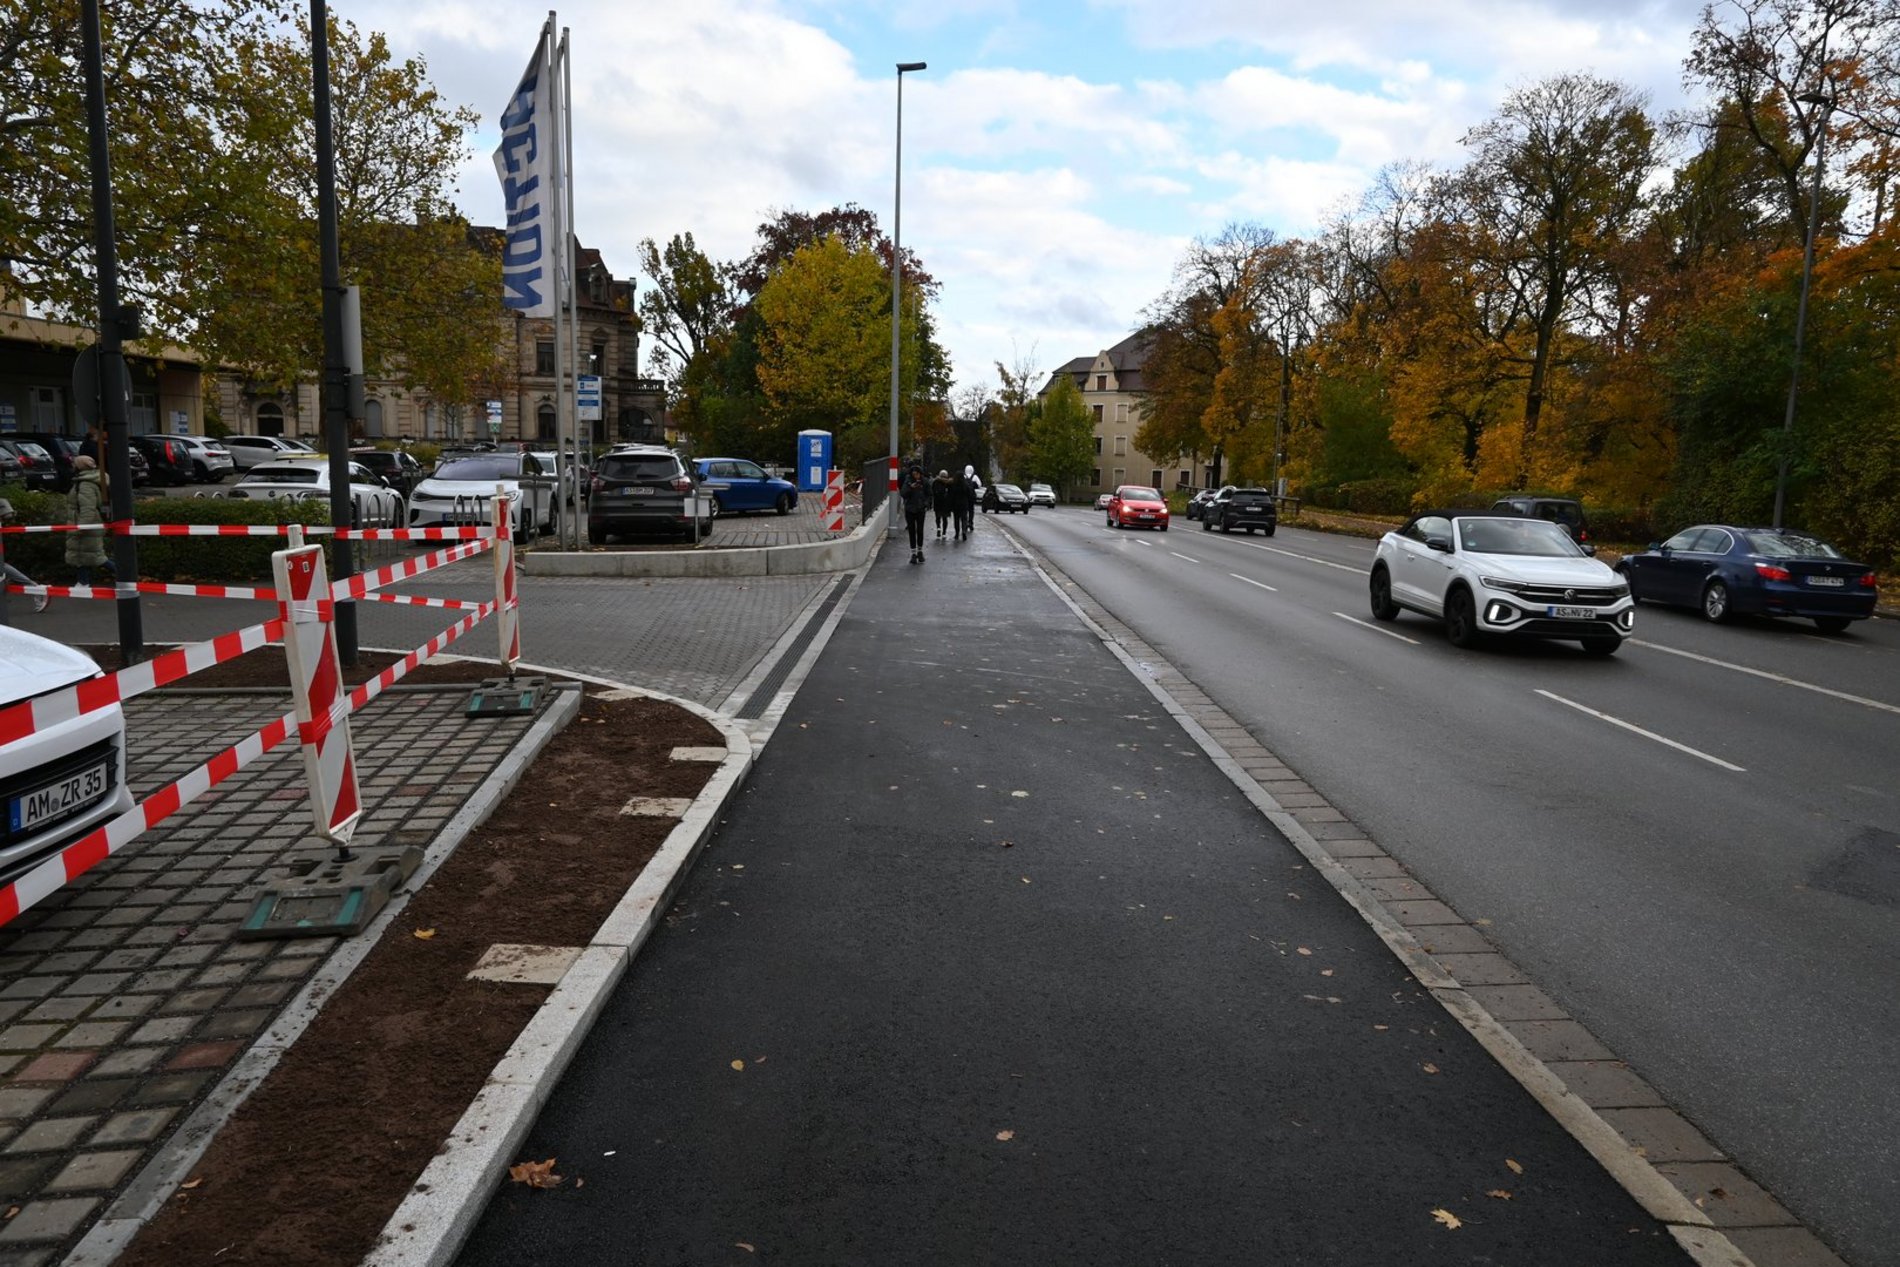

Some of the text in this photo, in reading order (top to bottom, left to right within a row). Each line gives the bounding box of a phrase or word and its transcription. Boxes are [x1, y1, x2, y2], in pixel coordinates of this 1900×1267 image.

[1556, 607, 1567, 617] AS
[1583, 609, 1594, 618] 22
[27, 790, 50, 823] AM
[60, 778, 81, 808] ZR
[84, 769, 102, 797] 35
